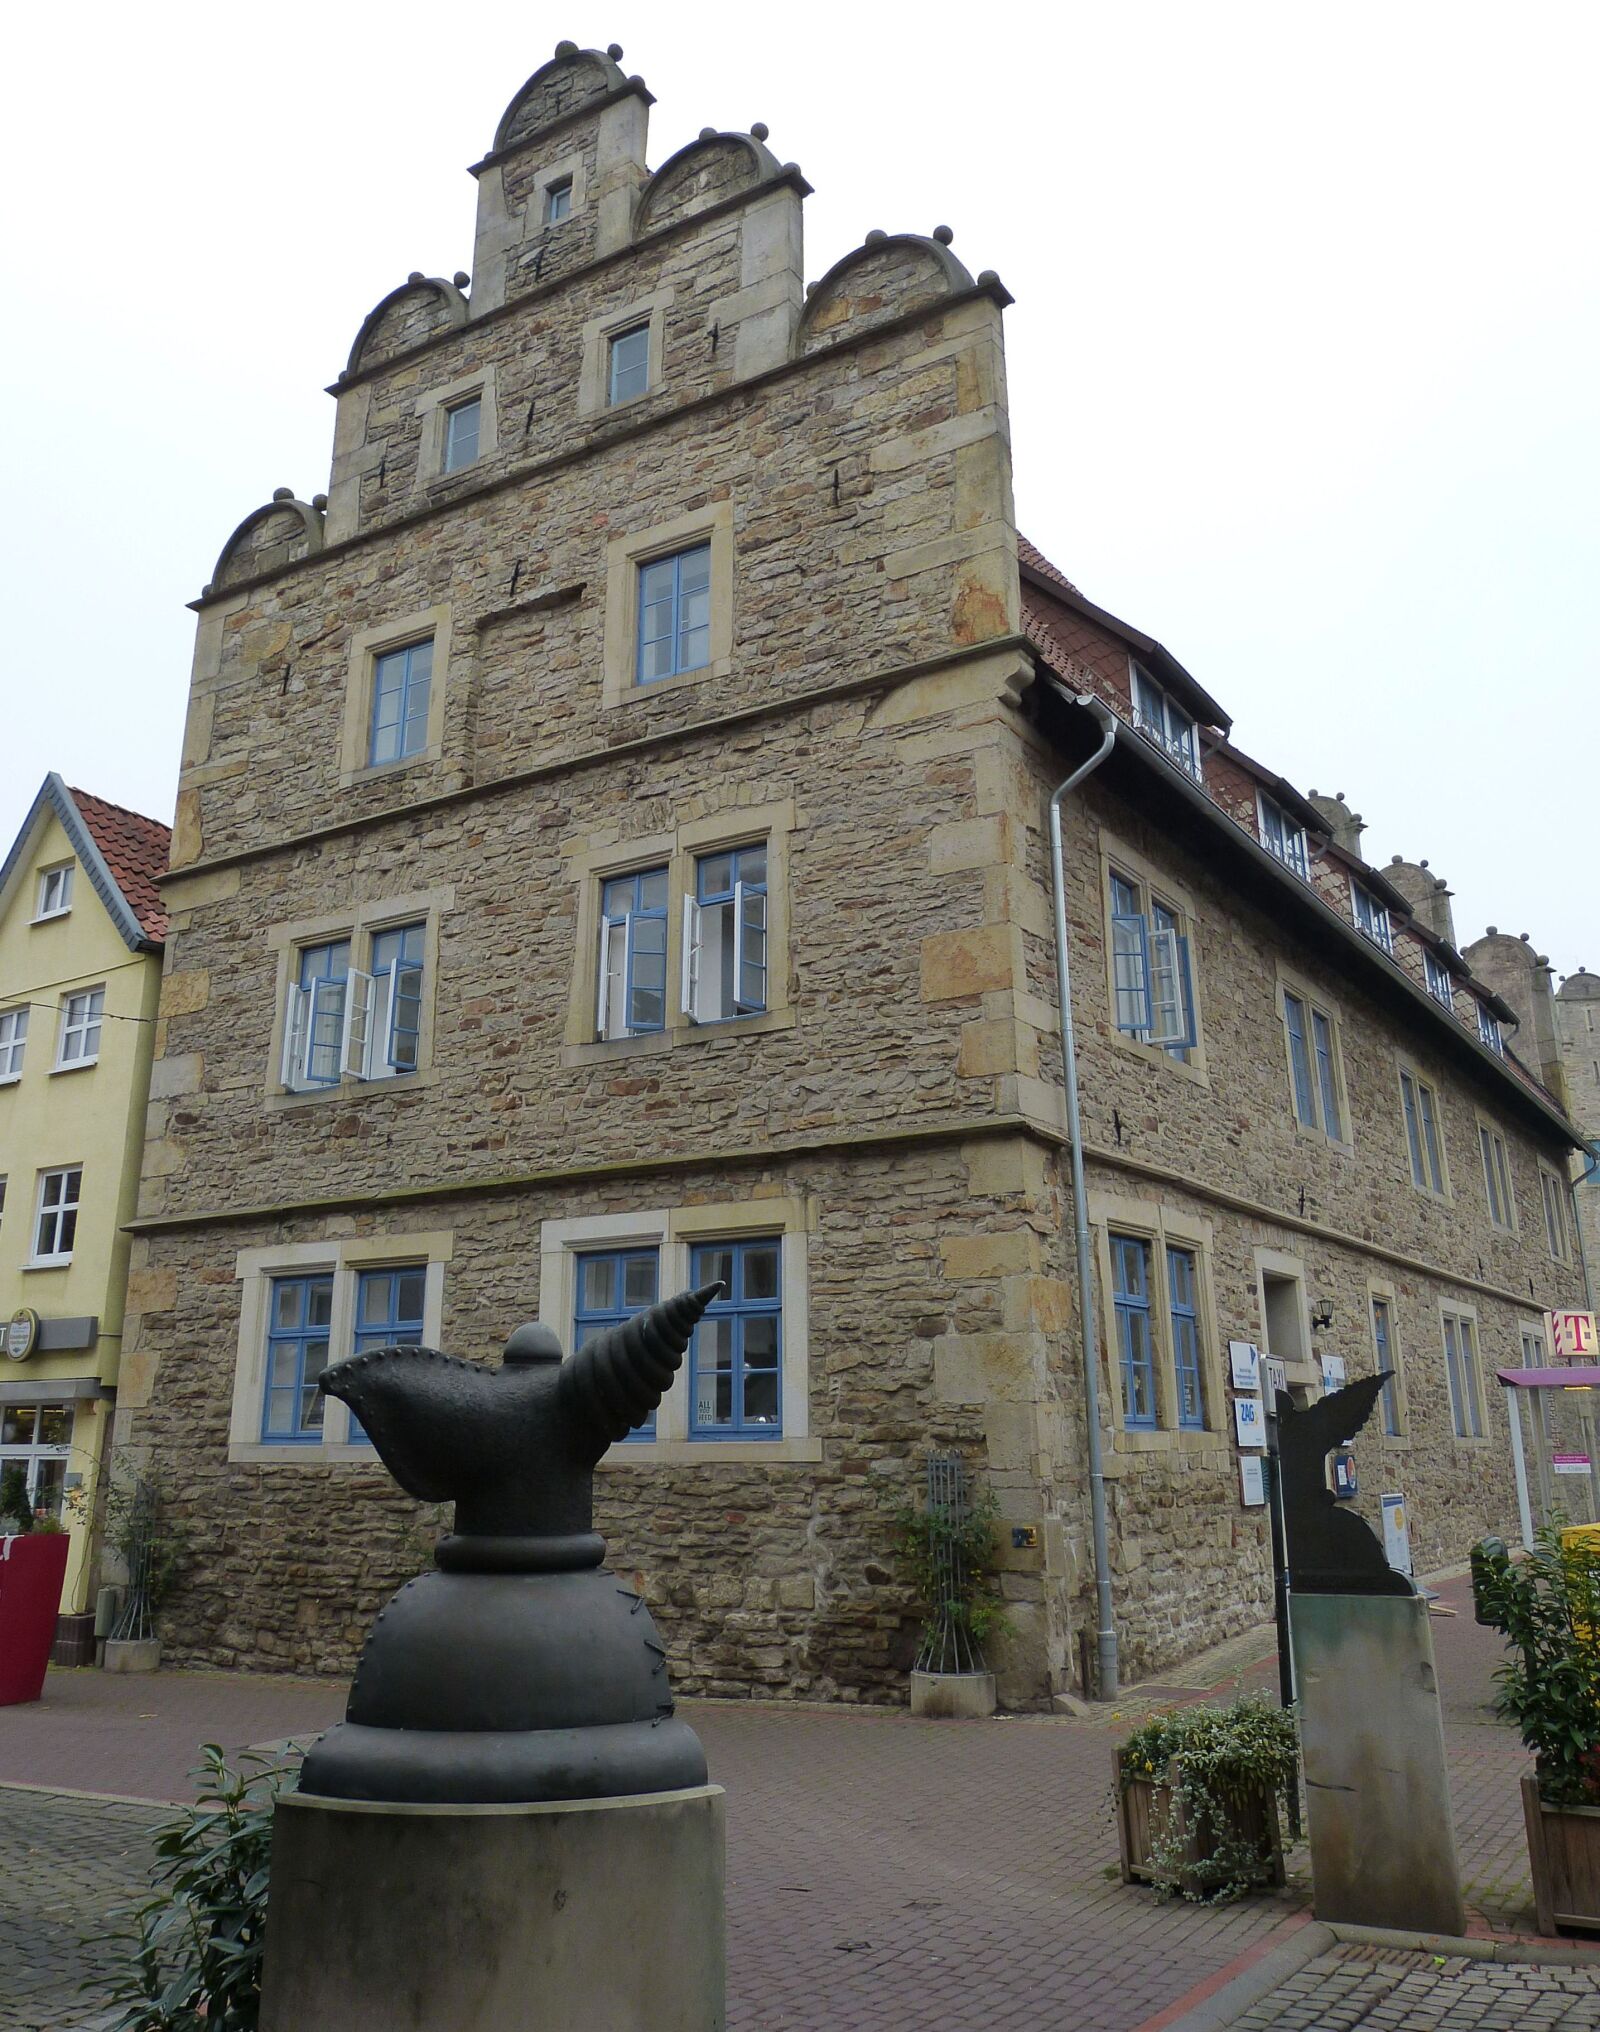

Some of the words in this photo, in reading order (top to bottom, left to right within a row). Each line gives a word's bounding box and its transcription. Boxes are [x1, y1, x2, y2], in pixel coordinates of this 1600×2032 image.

[1564, 1315, 1590, 1351] T
[1268, 1367, 1284, 1389] TAXI
[699, 1401, 711, 1409] ALL
[1241, 1403, 1255, 1422] ZAG
